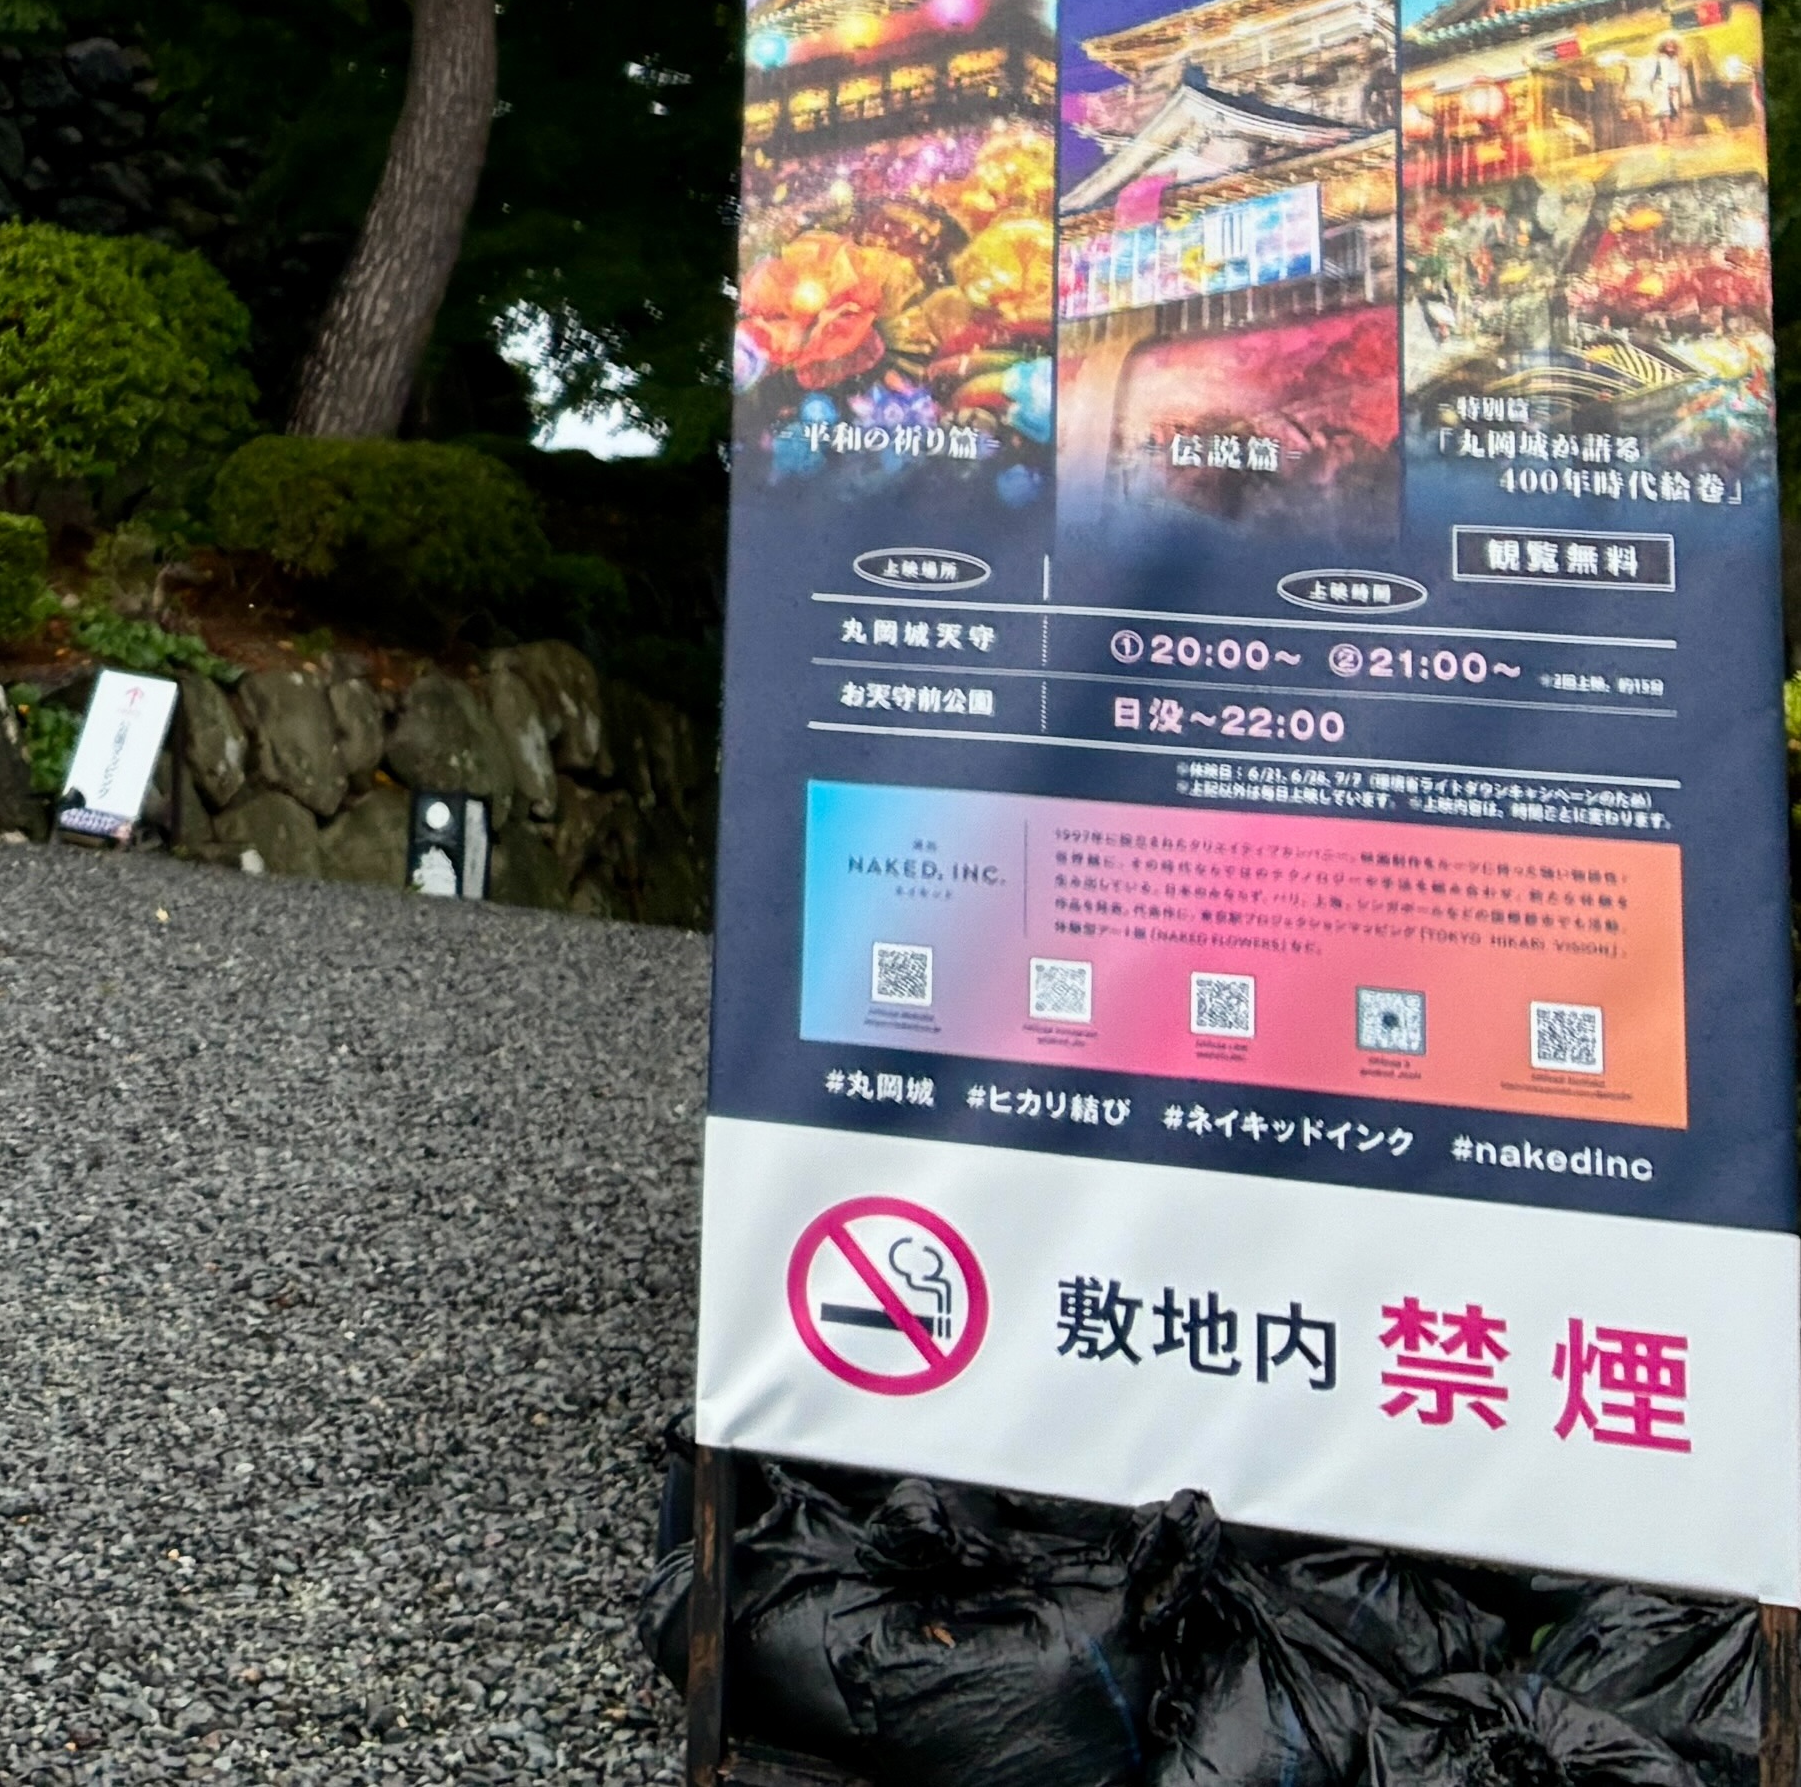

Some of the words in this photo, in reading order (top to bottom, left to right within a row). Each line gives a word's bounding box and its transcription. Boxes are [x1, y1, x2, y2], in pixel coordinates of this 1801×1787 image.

[1457, 396, 1530, 423] 特別篇
[803, 422, 980, 459] 平和の祈り篇
[1169, 433, 1278, 473] 伝説篇
[1438, 426, 1641, 464] 「丸岡城が語る
[1498, 467, 1743, 505] 400年時代絵巻」
[1486, 539, 1638, 577] 観覧無料
[841, 617, 996, 652] 丸岡城天守
[840, 681, 995, 717] お天守前公園
[952, 863, 1007, 886] INC.
[824, 1070, 935, 1107] #丸岡城
[965, 1085, 1131, 1126] #ヒカリ結び
[1164, 1105, 1415, 1157] #ネイキッドインク
[1451, 1135, 1655, 1184] #nakedinc
[1056, 1274, 1338, 1392] 敷地内
[1378, 1296, 1693, 1454] 禁煙
